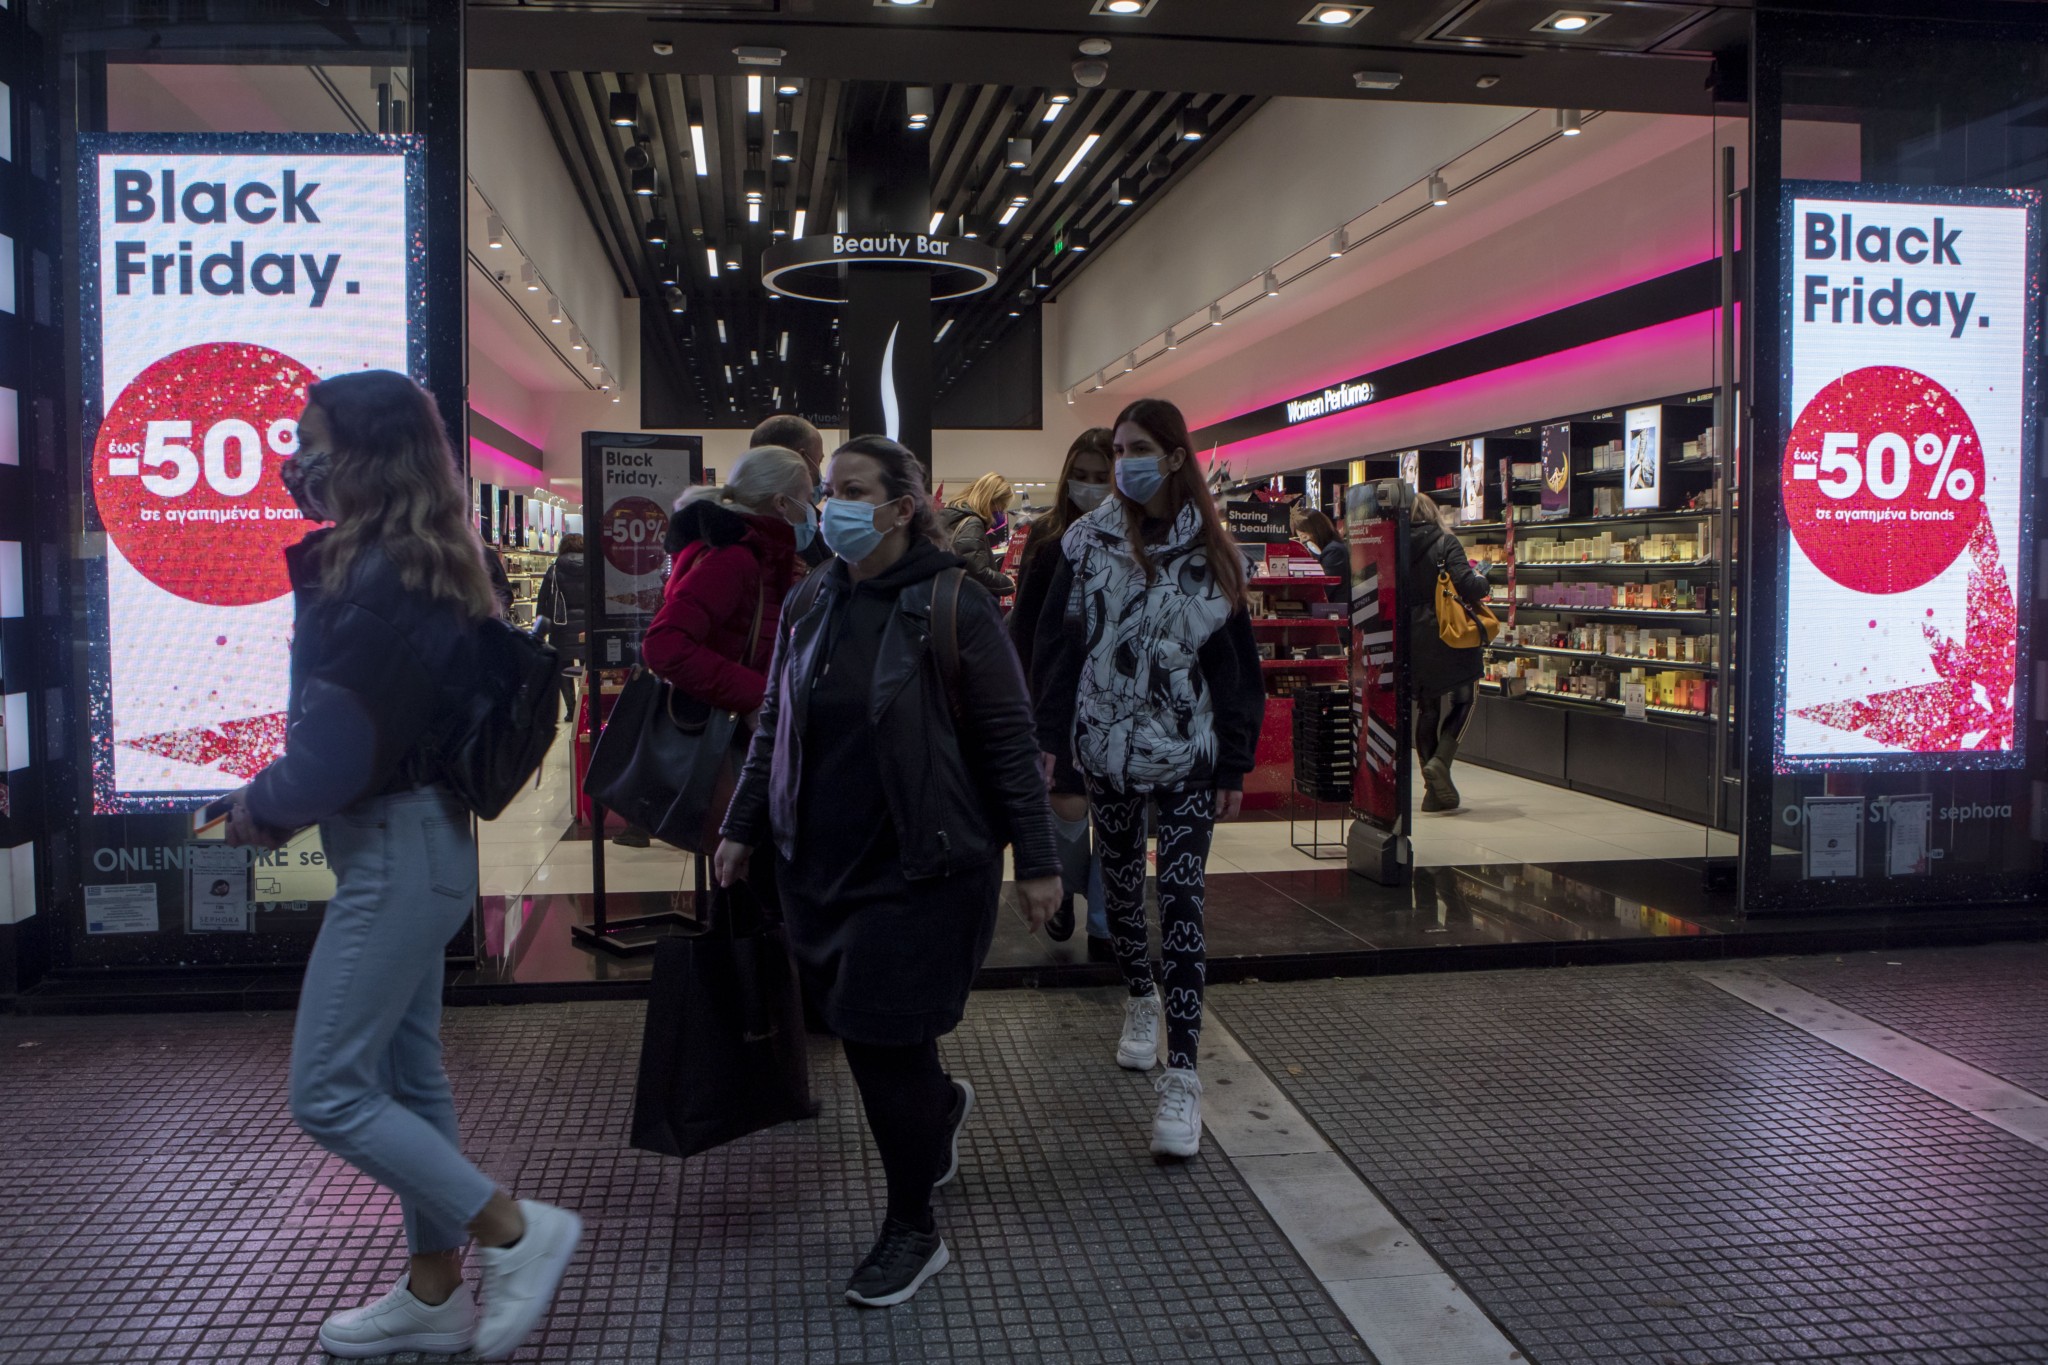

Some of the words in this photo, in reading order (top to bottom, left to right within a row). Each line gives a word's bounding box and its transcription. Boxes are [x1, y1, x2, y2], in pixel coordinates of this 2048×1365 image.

[114, 169, 321, 224] Black
[833, 233, 911, 256] Beauty
[917, 235, 949, 255] Bar
[1805, 212, 1963, 265] Black
[115, 241, 360, 308] Friday.
[1804, 275, 1990, 338] Friday.
[1287, 396, 1324, 423] Women
[1325, 382, 1370, 412] Perfume
[108, 438, 140, 456] έως
[1793, 448, 1818, 463] έως
[606, 452, 653, 467] Black
[606, 470, 662, 488] Friday.
[140, 508, 161, 521] σε
[165, 505, 260, 524] αγαπημένα
[264, 506, 304, 520] bran
[1229, 510, 1268, 523] Sharing
[1816, 508, 1832, 520] σε
[1835, 506, 1907, 523] αγαπημένα
[1910, 508, 1955, 521] brands
[1228, 522, 1237, 532] is
[1239, 522, 1288, 534] beautiful.
[1939, 802, 2012, 823] sephora
